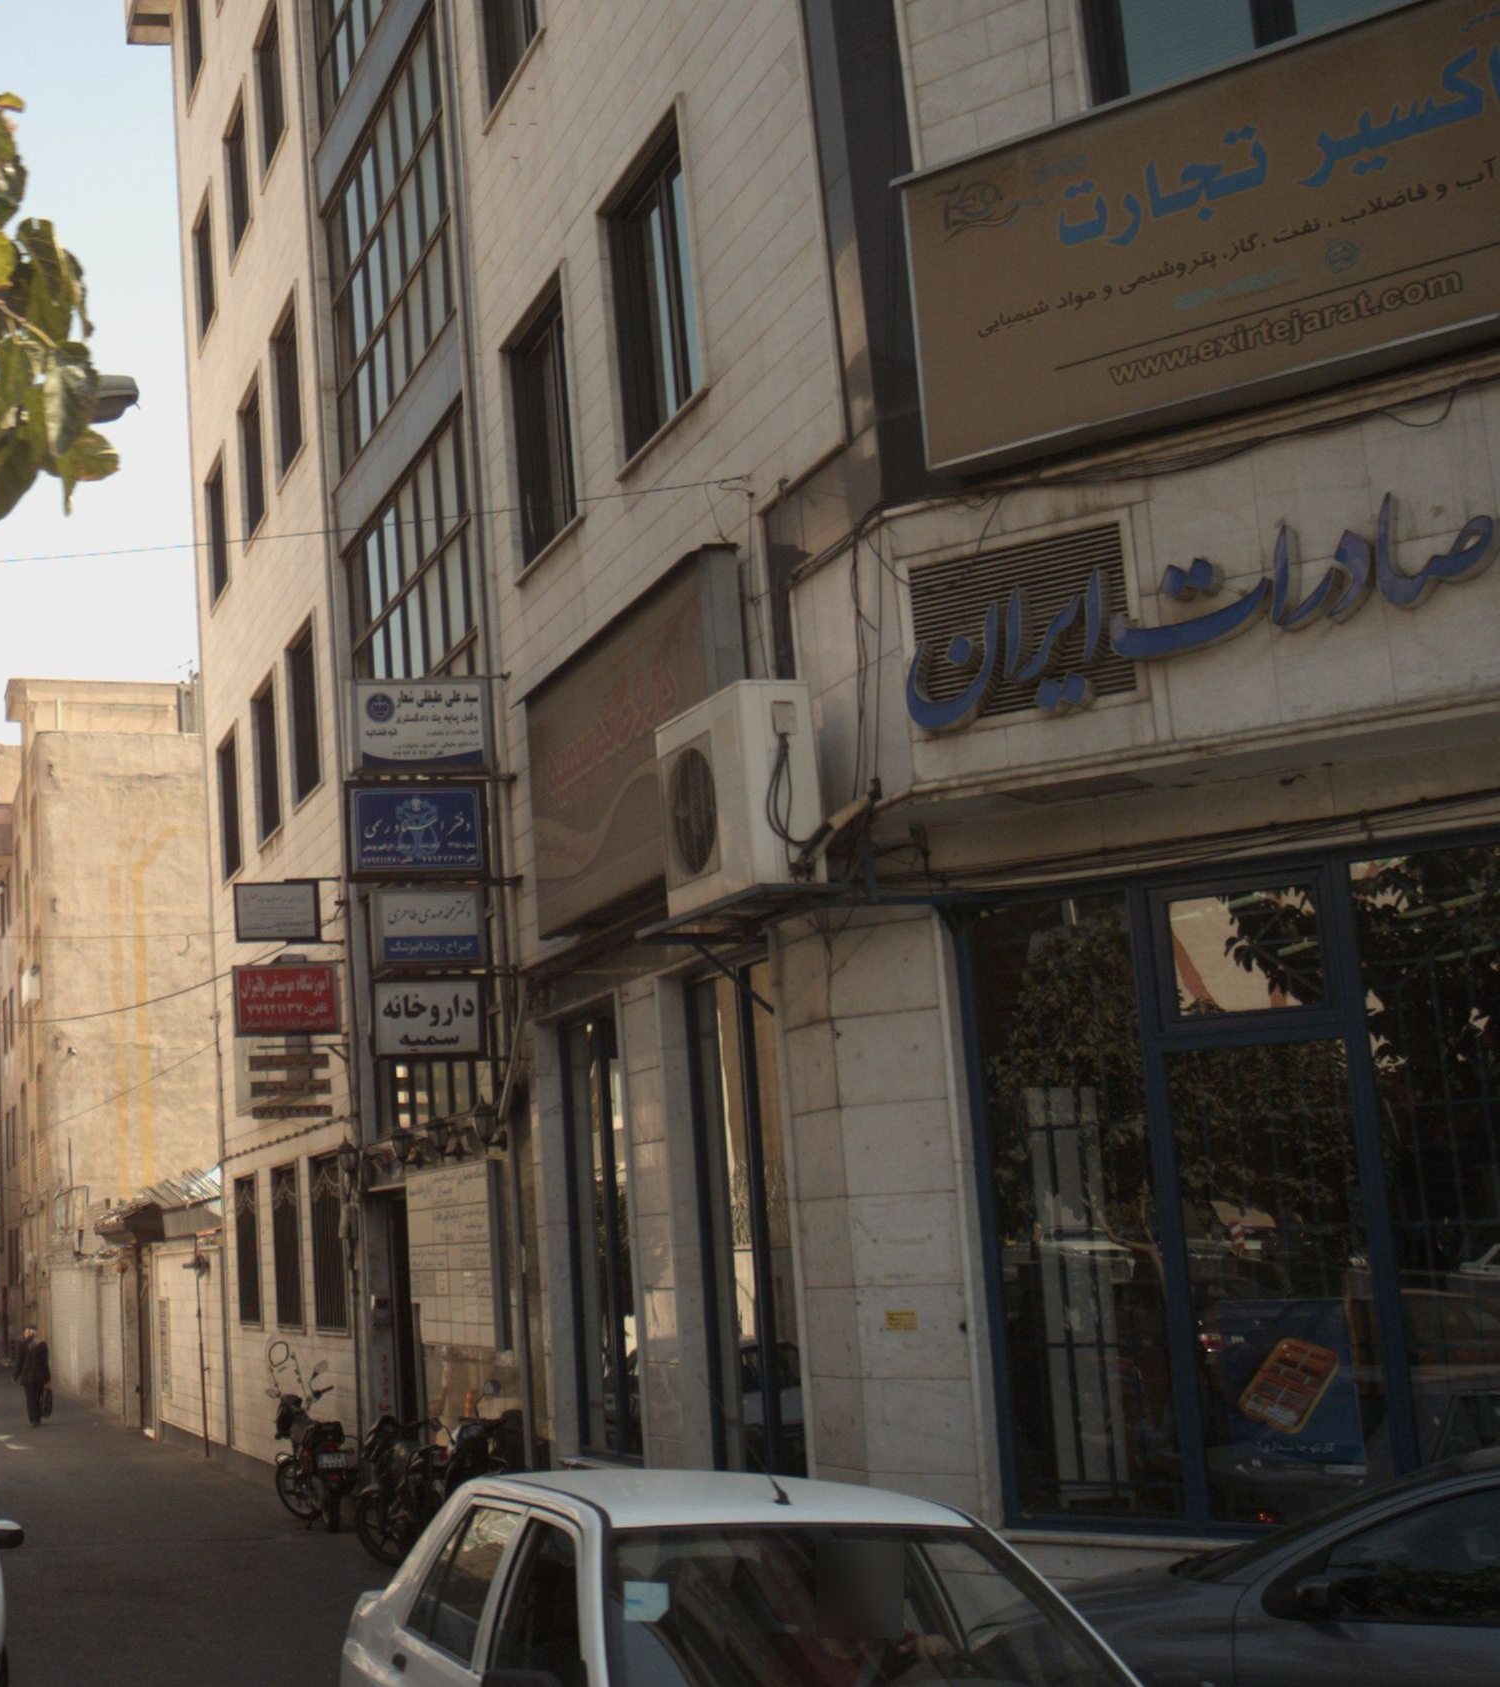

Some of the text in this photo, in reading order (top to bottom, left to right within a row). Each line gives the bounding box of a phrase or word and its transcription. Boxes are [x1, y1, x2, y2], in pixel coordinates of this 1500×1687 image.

[1057, 123, 1268, 247] تجارت
[1435, 181, 1448, 201] و
[1118, 246, 1216, 296] پتروشیمی
[1056, 286, 1098, 315] مواد
[1101, 282, 1113, 303] و
[977, 300, 1050, 339] شیمیایی
[1108, 266, 1464, 387] www.exirtejarat.com
[905, 490, 1496, 734] صادرات ایران
[364, 812, 471, 839] دفتر اسناد رسمی
[445, 938, 473, 954] جراح
[382, 992, 475, 1027] داروخانه
[398, 1031, 460, 1052] سمیه
